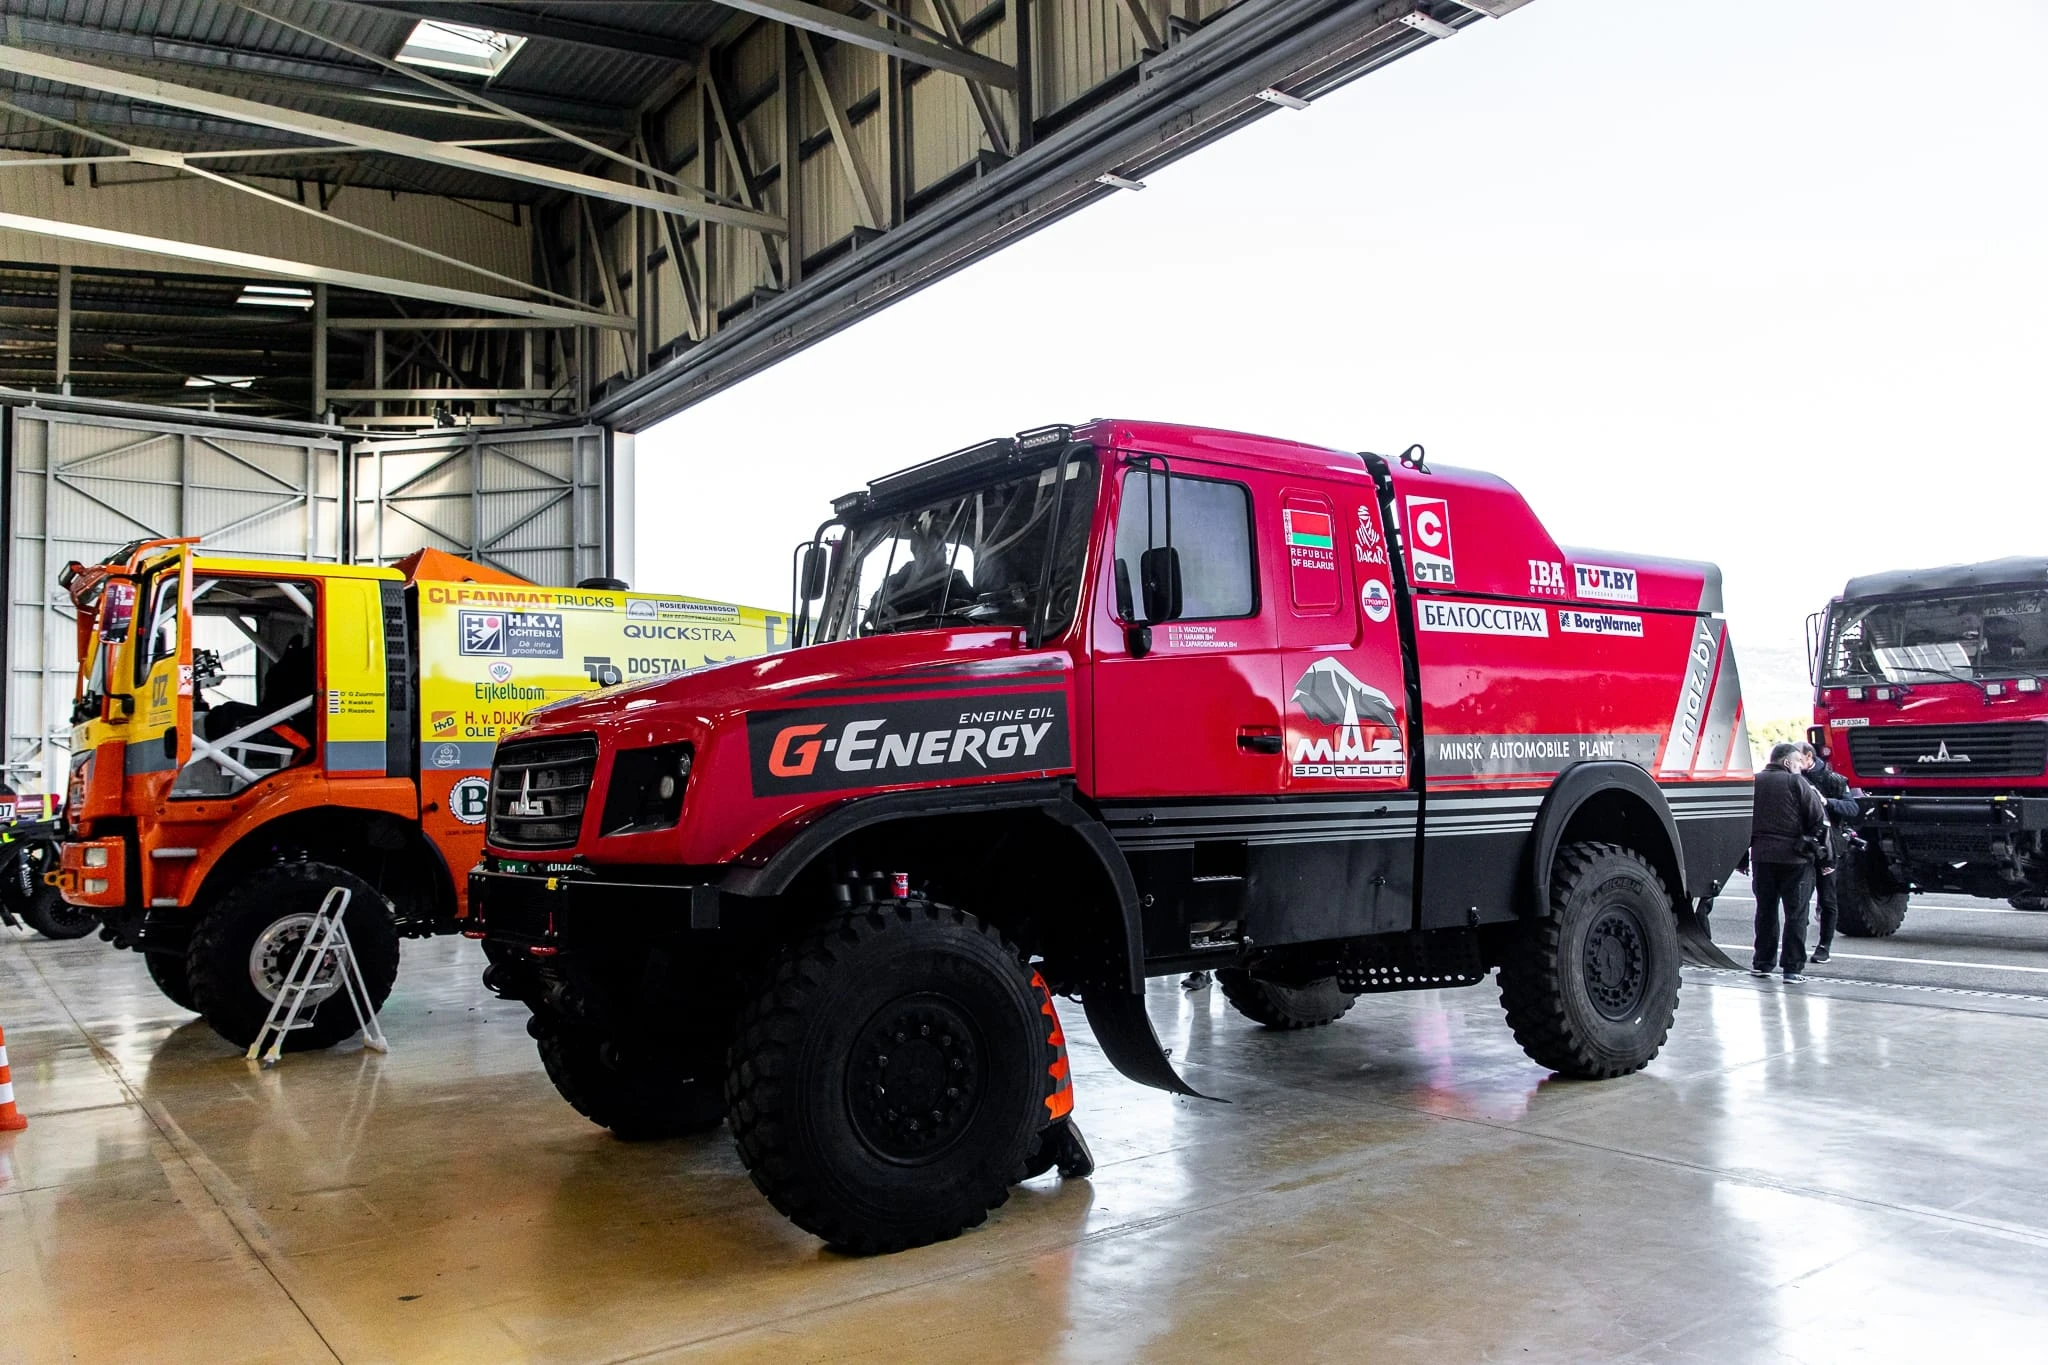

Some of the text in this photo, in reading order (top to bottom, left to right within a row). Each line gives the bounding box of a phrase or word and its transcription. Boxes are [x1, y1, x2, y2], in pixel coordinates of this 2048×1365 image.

[1290, 547, 1334, 560] REPUBLIC
[1355, 543, 1387, 565] DAKAR
[1291, 558, 1335, 571] OF BELARUS
[1528, 559, 1565, 588] IBA
[1576, 567, 1635, 592] TUT.BY
[428, 587, 615, 609] CLEANMAT TRUCKS
[1529, 586, 1565, 597] GROUP
[508, 614, 561, 629] H.K.V.
[1424, 604, 1542, 632] БЕЛГОССТРАХ
[1574, 612, 1642, 633] BorgWarner
[508, 628, 561, 639] OCHTEN B.V.
[623, 624, 737, 642] QUICKSTRA
[512, 647, 559, 656] groothandel
[475, 682, 545, 703] Eijkelboom
[1678, 619, 1717, 749] maz.by
[433, 716, 455, 732] HvD
[465, 711, 478, 725] H.
[481, 713, 491, 725] v.
[959, 707, 1055, 724] ENGINE OIL
[465, 726, 496, 737] OLIE
[1439, 740, 1614, 761] MINSK AUTOMOBILE PLANT
[1294, 766, 1405, 775] SPORTAUTO
[461, 785, 488, 816] B
